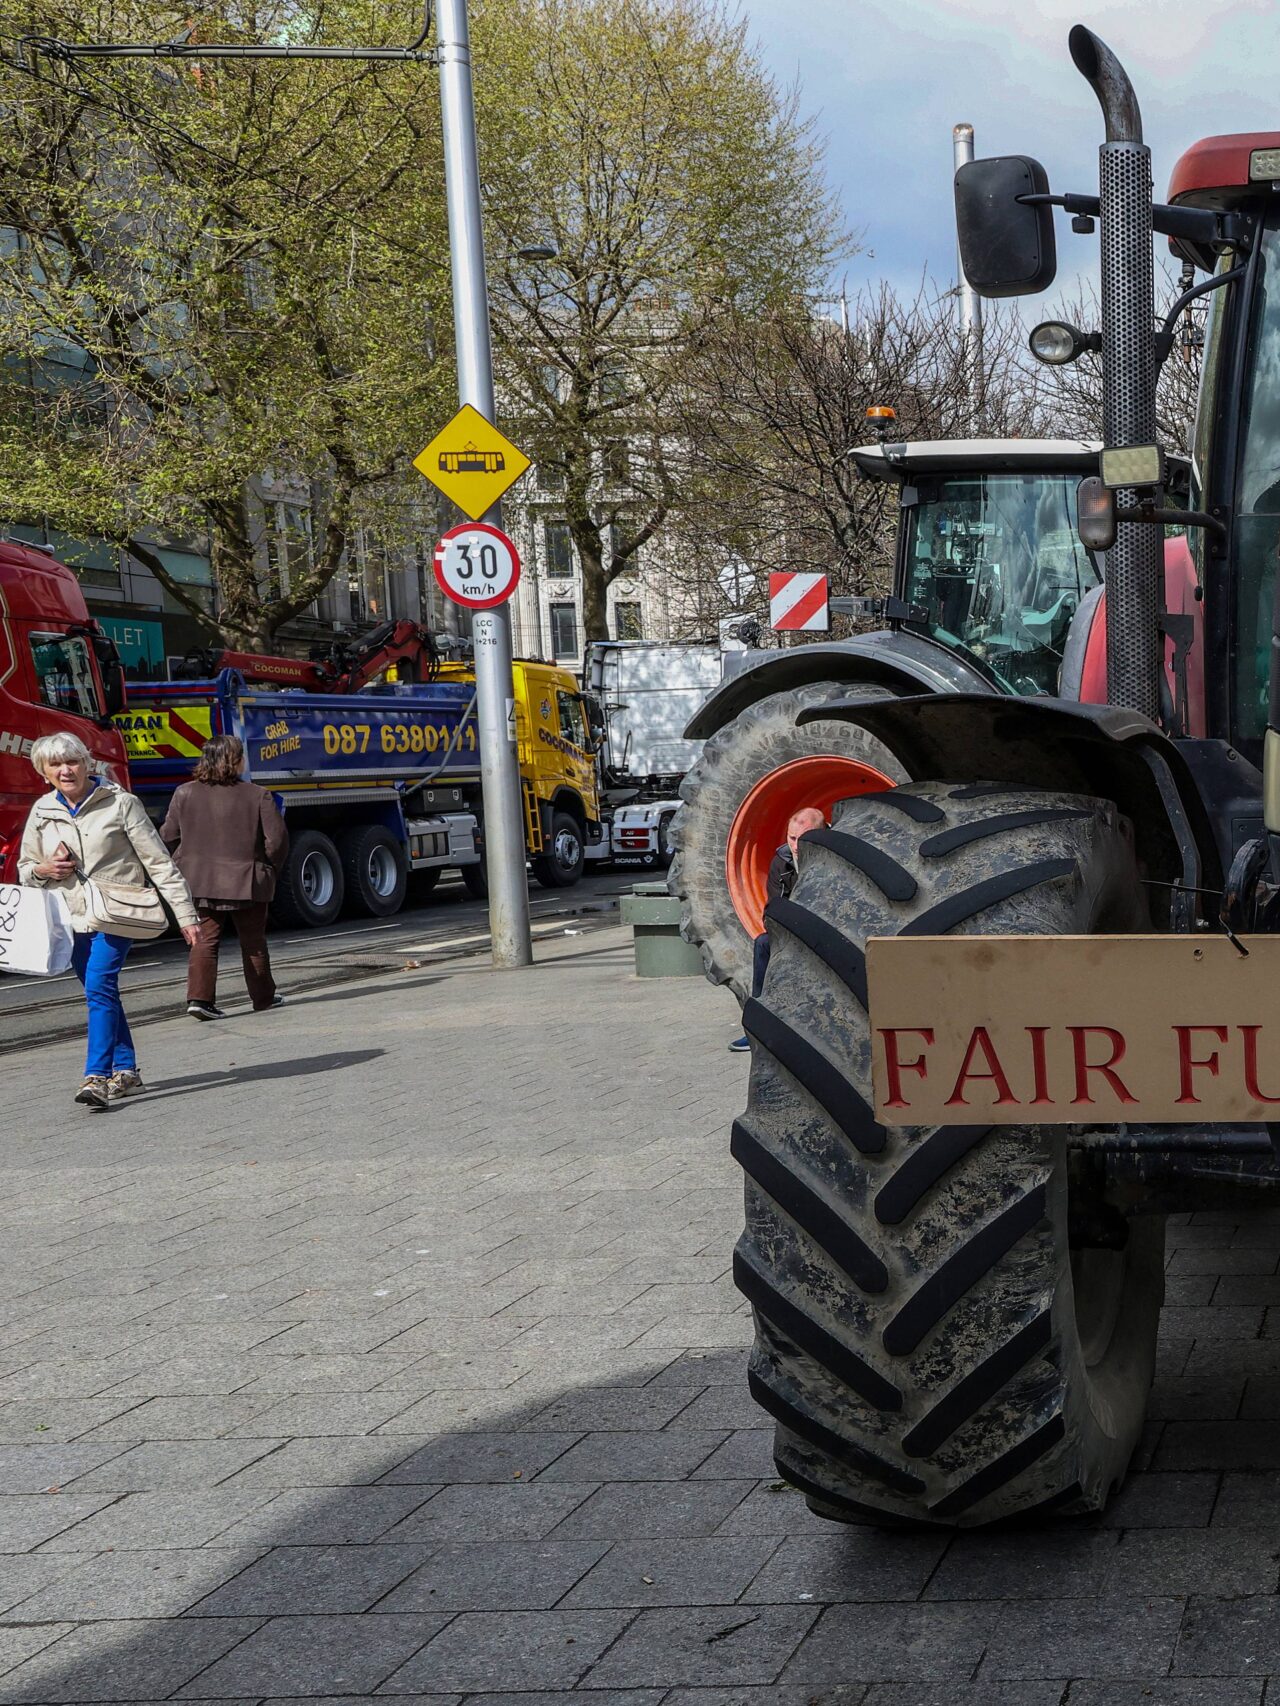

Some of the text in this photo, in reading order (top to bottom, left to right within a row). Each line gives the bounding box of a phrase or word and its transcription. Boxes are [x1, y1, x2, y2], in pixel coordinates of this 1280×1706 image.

[456, 544, 498, 579] 30
[462, 583, 495, 595] km/h
[476, 619, 493, 627] LCC
[113, 626, 143, 646] LET
[254, 663, 302, 676] COCOMAN
[264, 720, 289, 740] GRAB
[323, 724, 475, 754] 087 6380111
[260, 735, 301, 761] FOR HIRE
[876, 1026, 1140, 1107] FAIR
